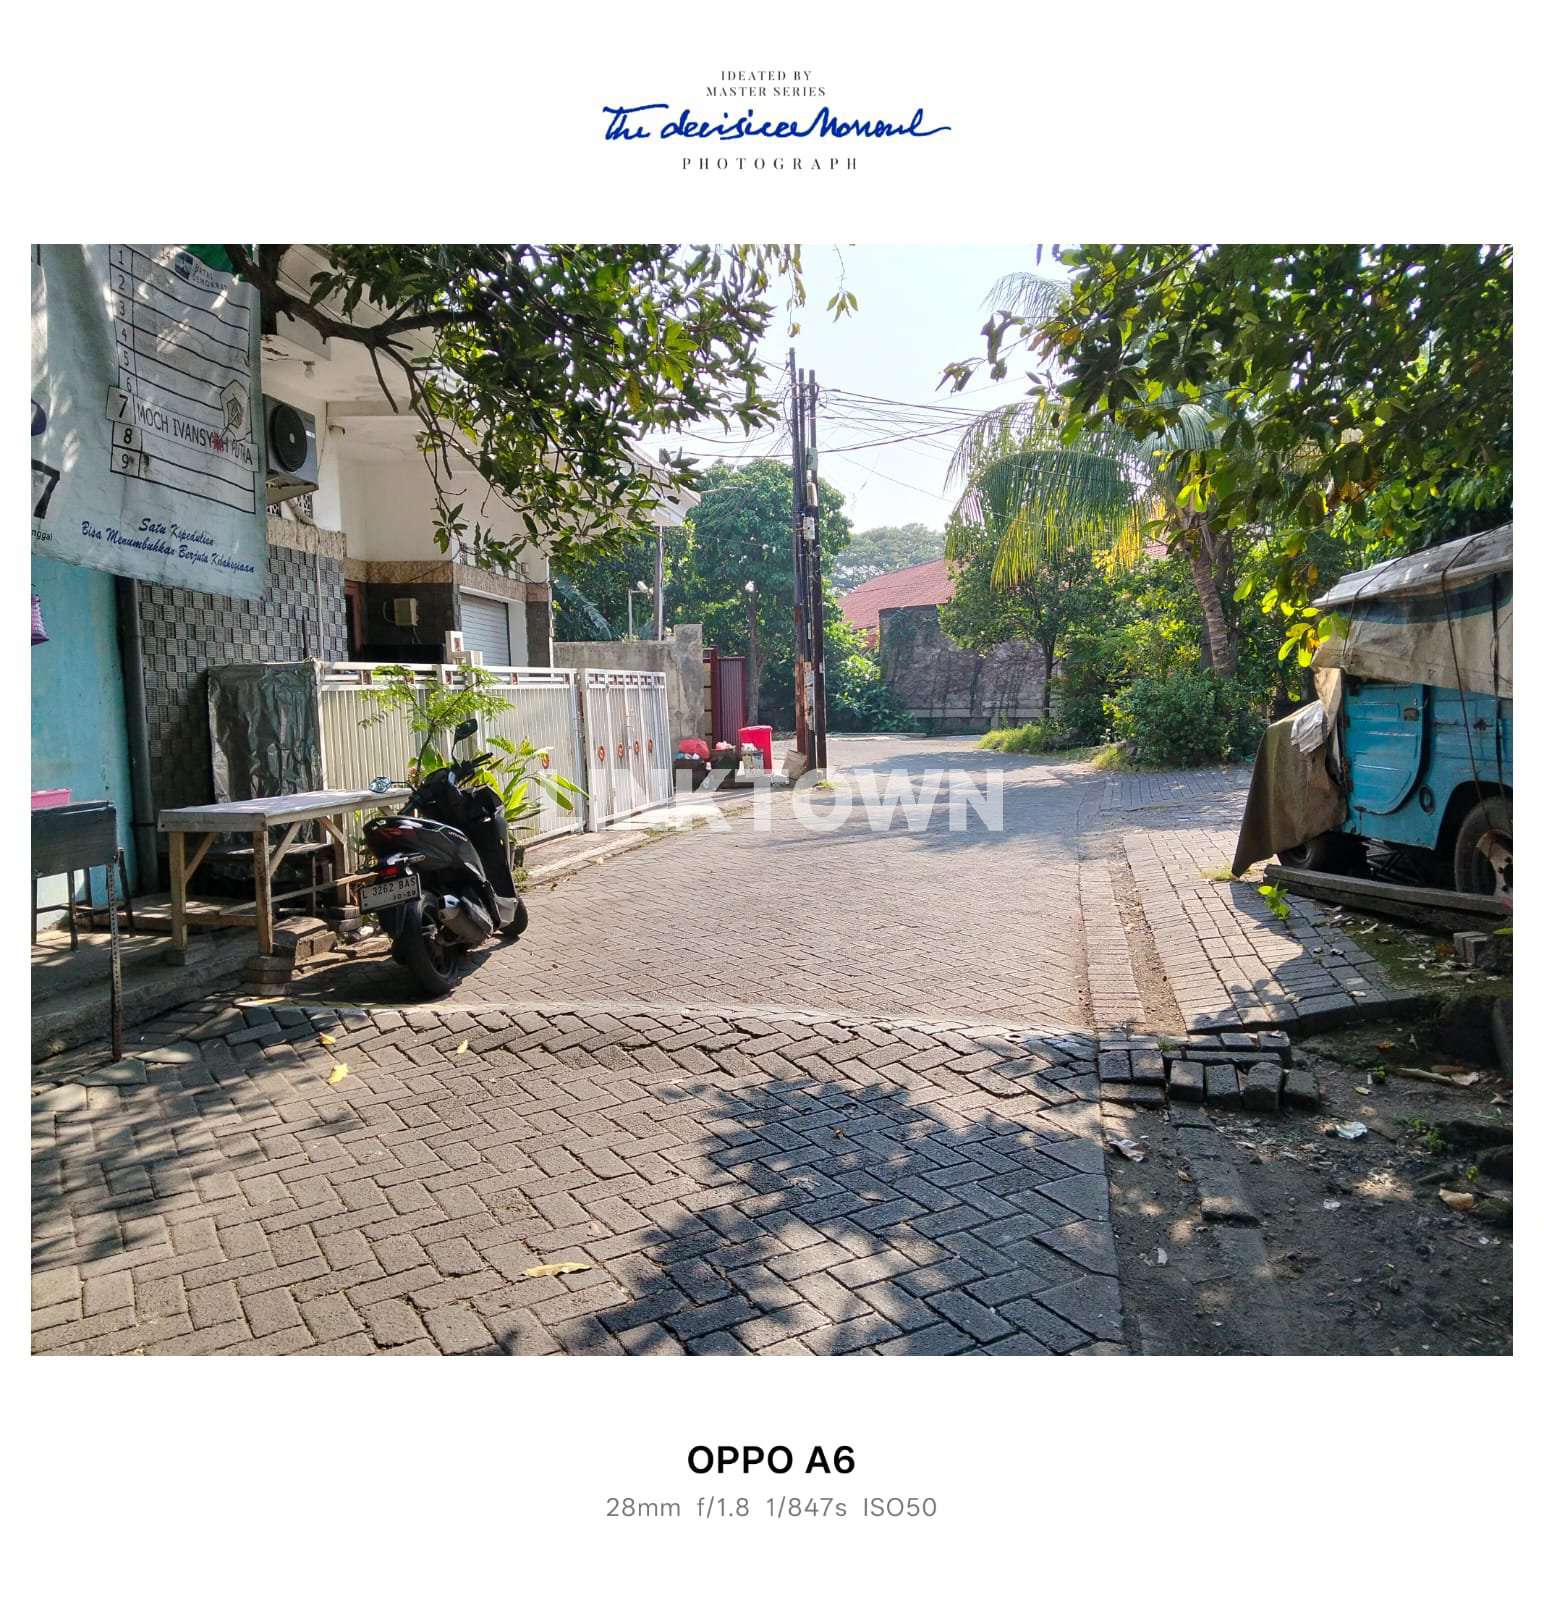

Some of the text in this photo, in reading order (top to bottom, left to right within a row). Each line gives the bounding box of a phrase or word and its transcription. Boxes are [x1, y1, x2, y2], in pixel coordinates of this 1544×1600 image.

[118, 249, 124, 265] 1
[118, 274, 125, 291] 2
[119, 300, 126, 317] 3
[121, 327, 127, 342] 4
[123, 351, 130, 367] 5
[125, 376, 132, 392] 6
[118, 394, 129, 419] 7
[136, 402, 169, 434] MOCH
[123, 427, 133, 445] 8
[121, 453, 130, 470] 9
[138, 517, 168, 535] Satu
[81, 520, 103, 541] Bisa
[105, 526, 176, 556] Menumbuhkan
[178, 544, 209, 566] Berjuta
[362, 889, 368, 899] L
[373, 883, 394, 896] 3262
